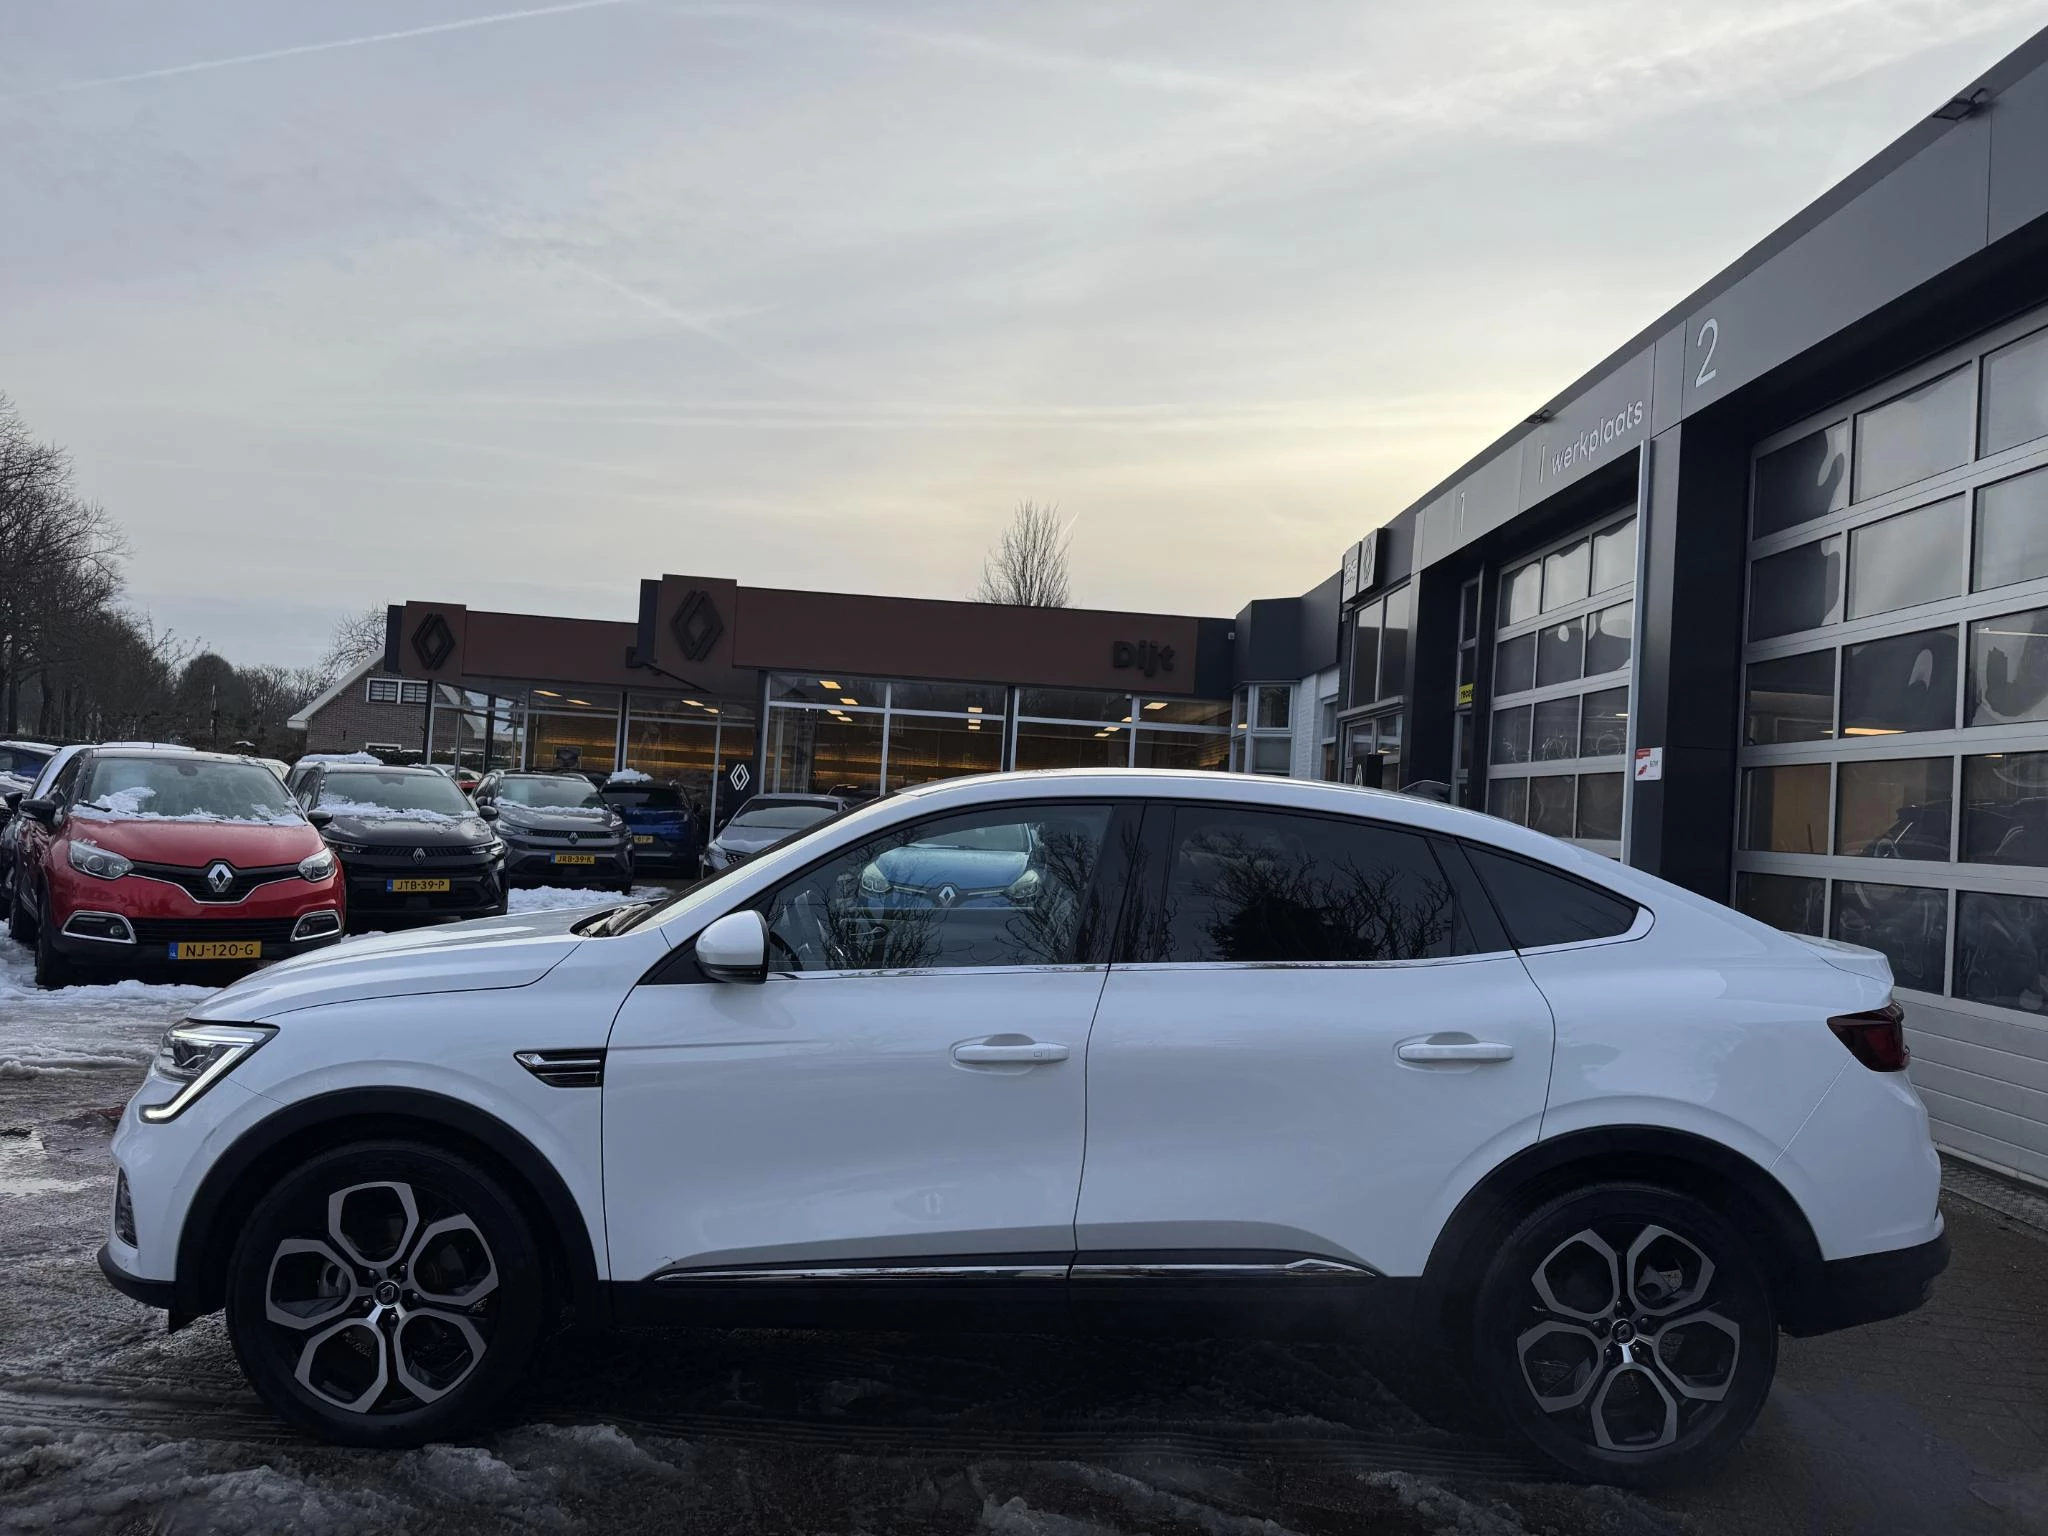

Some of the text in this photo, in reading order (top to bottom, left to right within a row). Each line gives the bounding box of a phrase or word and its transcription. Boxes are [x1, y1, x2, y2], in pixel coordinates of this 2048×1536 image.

[1695, 318, 1719, 388] 2
[1551, 400, 1643, 476] werkplaats
[1459, 491, 1466, 534] 1
[1113, 640, 1175, 677] Dijt
[397, 880, 445, 890] JTB-39-P
[186, 943, 254, 957] NJ-120-G
